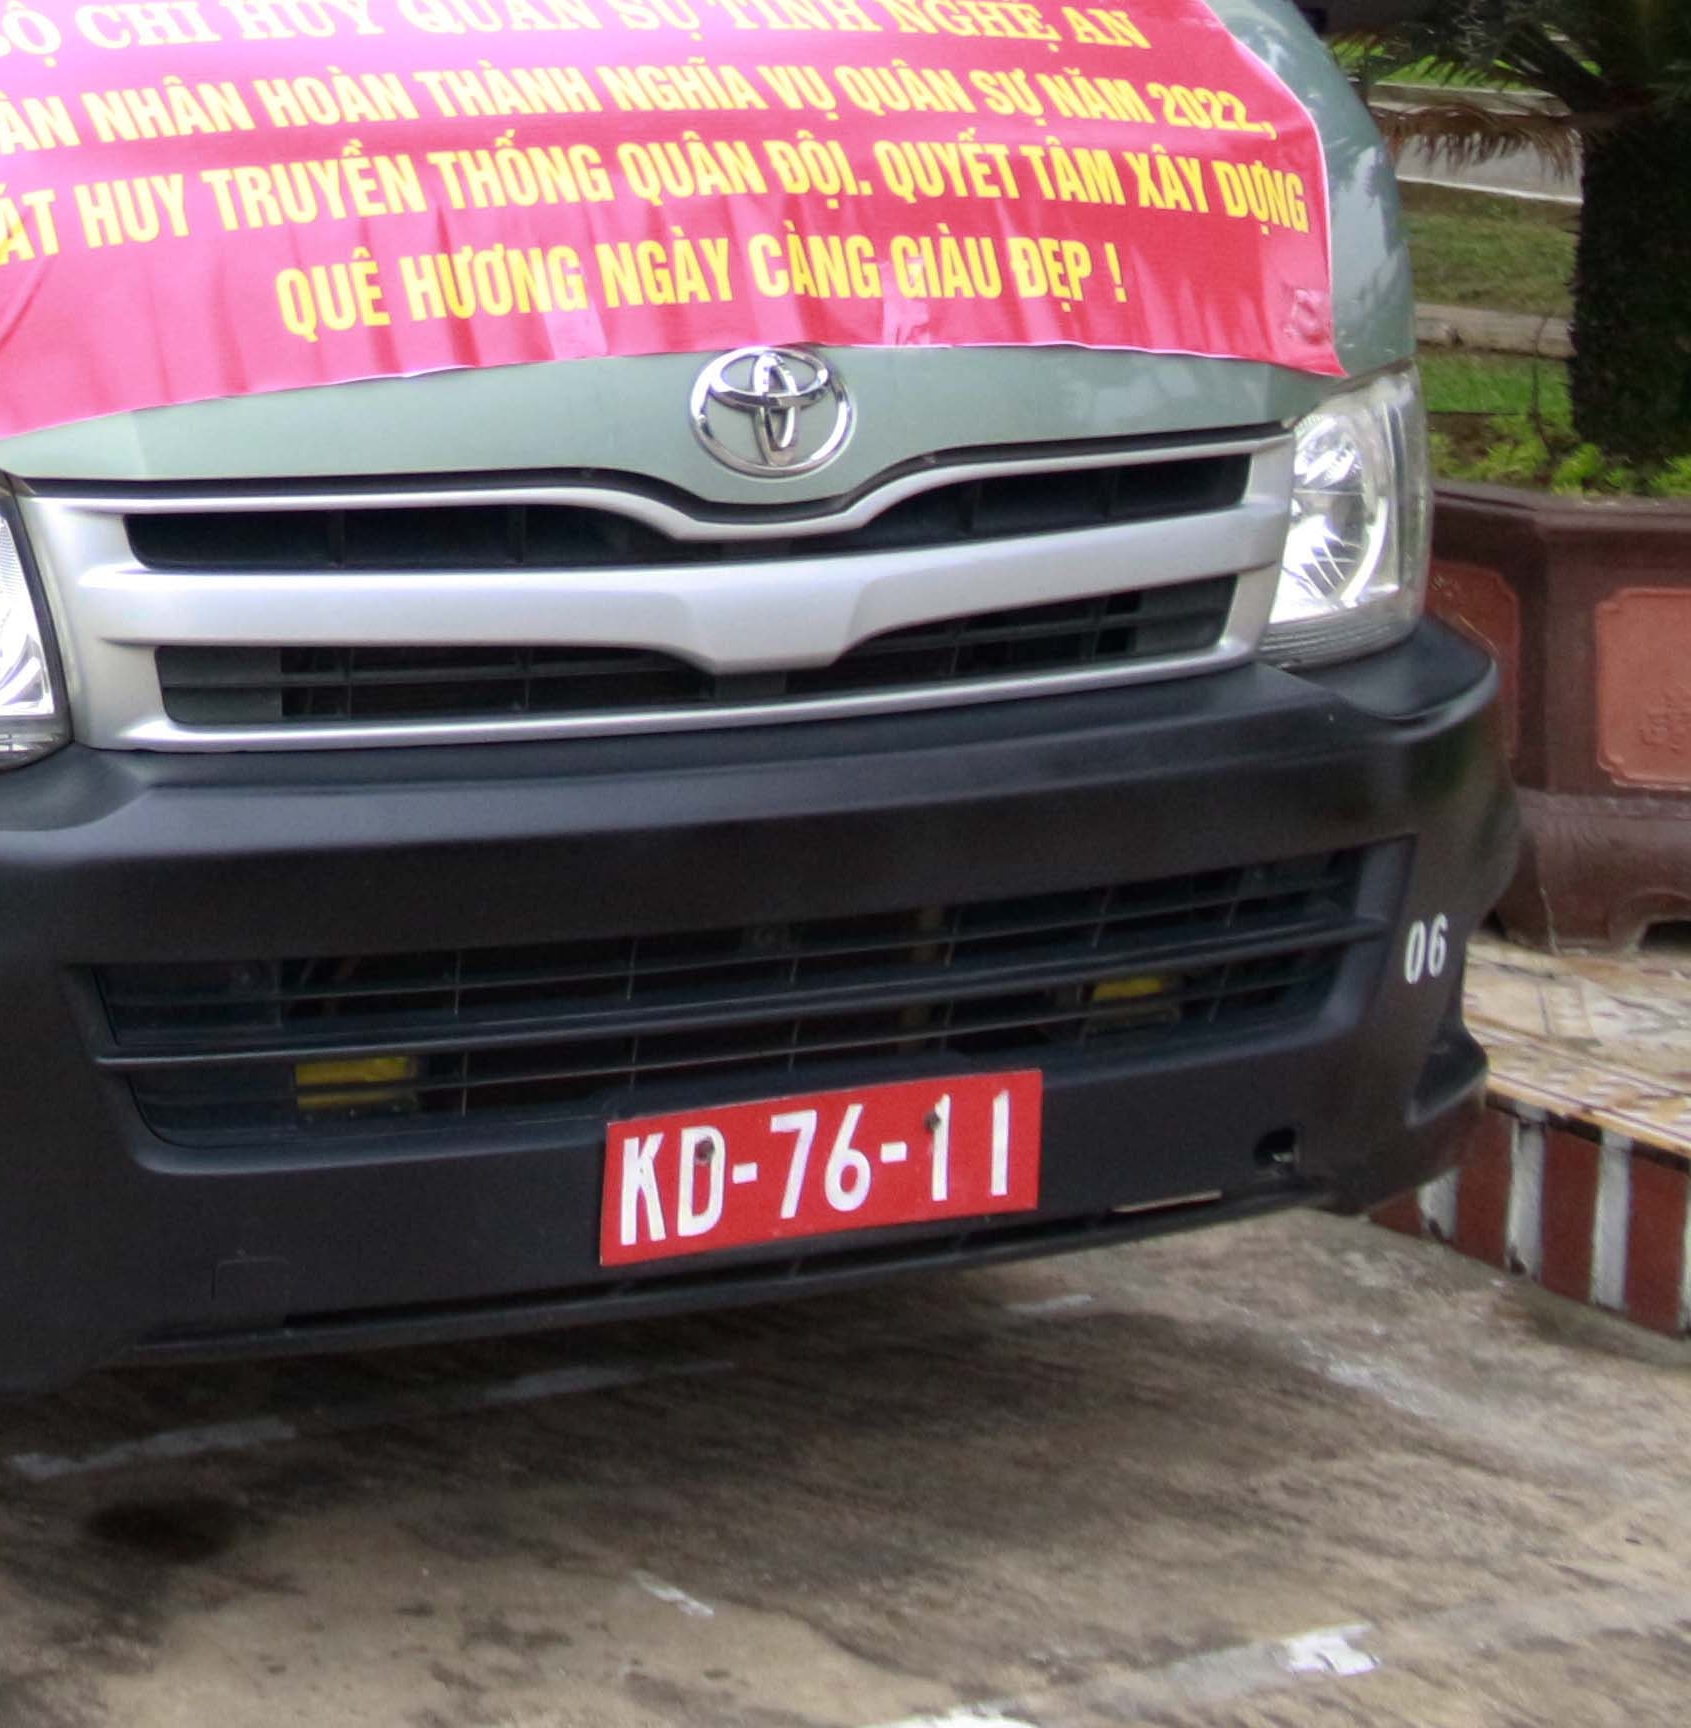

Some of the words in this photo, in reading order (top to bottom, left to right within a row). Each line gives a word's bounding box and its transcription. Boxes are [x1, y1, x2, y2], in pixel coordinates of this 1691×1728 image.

[1063, 5, 1153, 49] AN
[80, 75, 256, 144] NHÂN
[253, 65, 420, 127] HOÀN
[418, 60, 603, 118] THÀNH
[596, 57, 768, 112] NGHĨA
[756, 65, 840, 121] VỤ
[834, 58, 977, 117] QUÂN
[970, 69, 1047, 126] SỰ
[1037, 66, 1156, 125] NĂM
[1147, 81, 1279, 142] 2022,
[73, 173, 191, 249] HUY
[200, 138, 428, 232] TRUYỀN
[427, 129, 616, 209] THỐNG
[616, 130, 768, 207] QUÂN
[762, 129, 873, 210] ĐỘI.
[873, 126, 1021, 205] QUYẾT
[1019, 136, 1127, 207] TÂM
[1123, 143, 1211, 215] XÂY
[1210, 160, 1312, 236] DỰNG
[275, 246, 392, 343] QUÊ
[399, 242, 590, 322] HƯƠNG
[594, 224, 735, 308] NGÀY
[748, 219, 883, 299] CÀNG
[889, 222, 1005, 300] GIÀU
[1007, 235, 1094, 313] ĐẸP
[1104, 241, 1128, 304] !
[1405, 913, 1448, 984] 06
[619, 1088, 1013, 1247] KD-76-11
